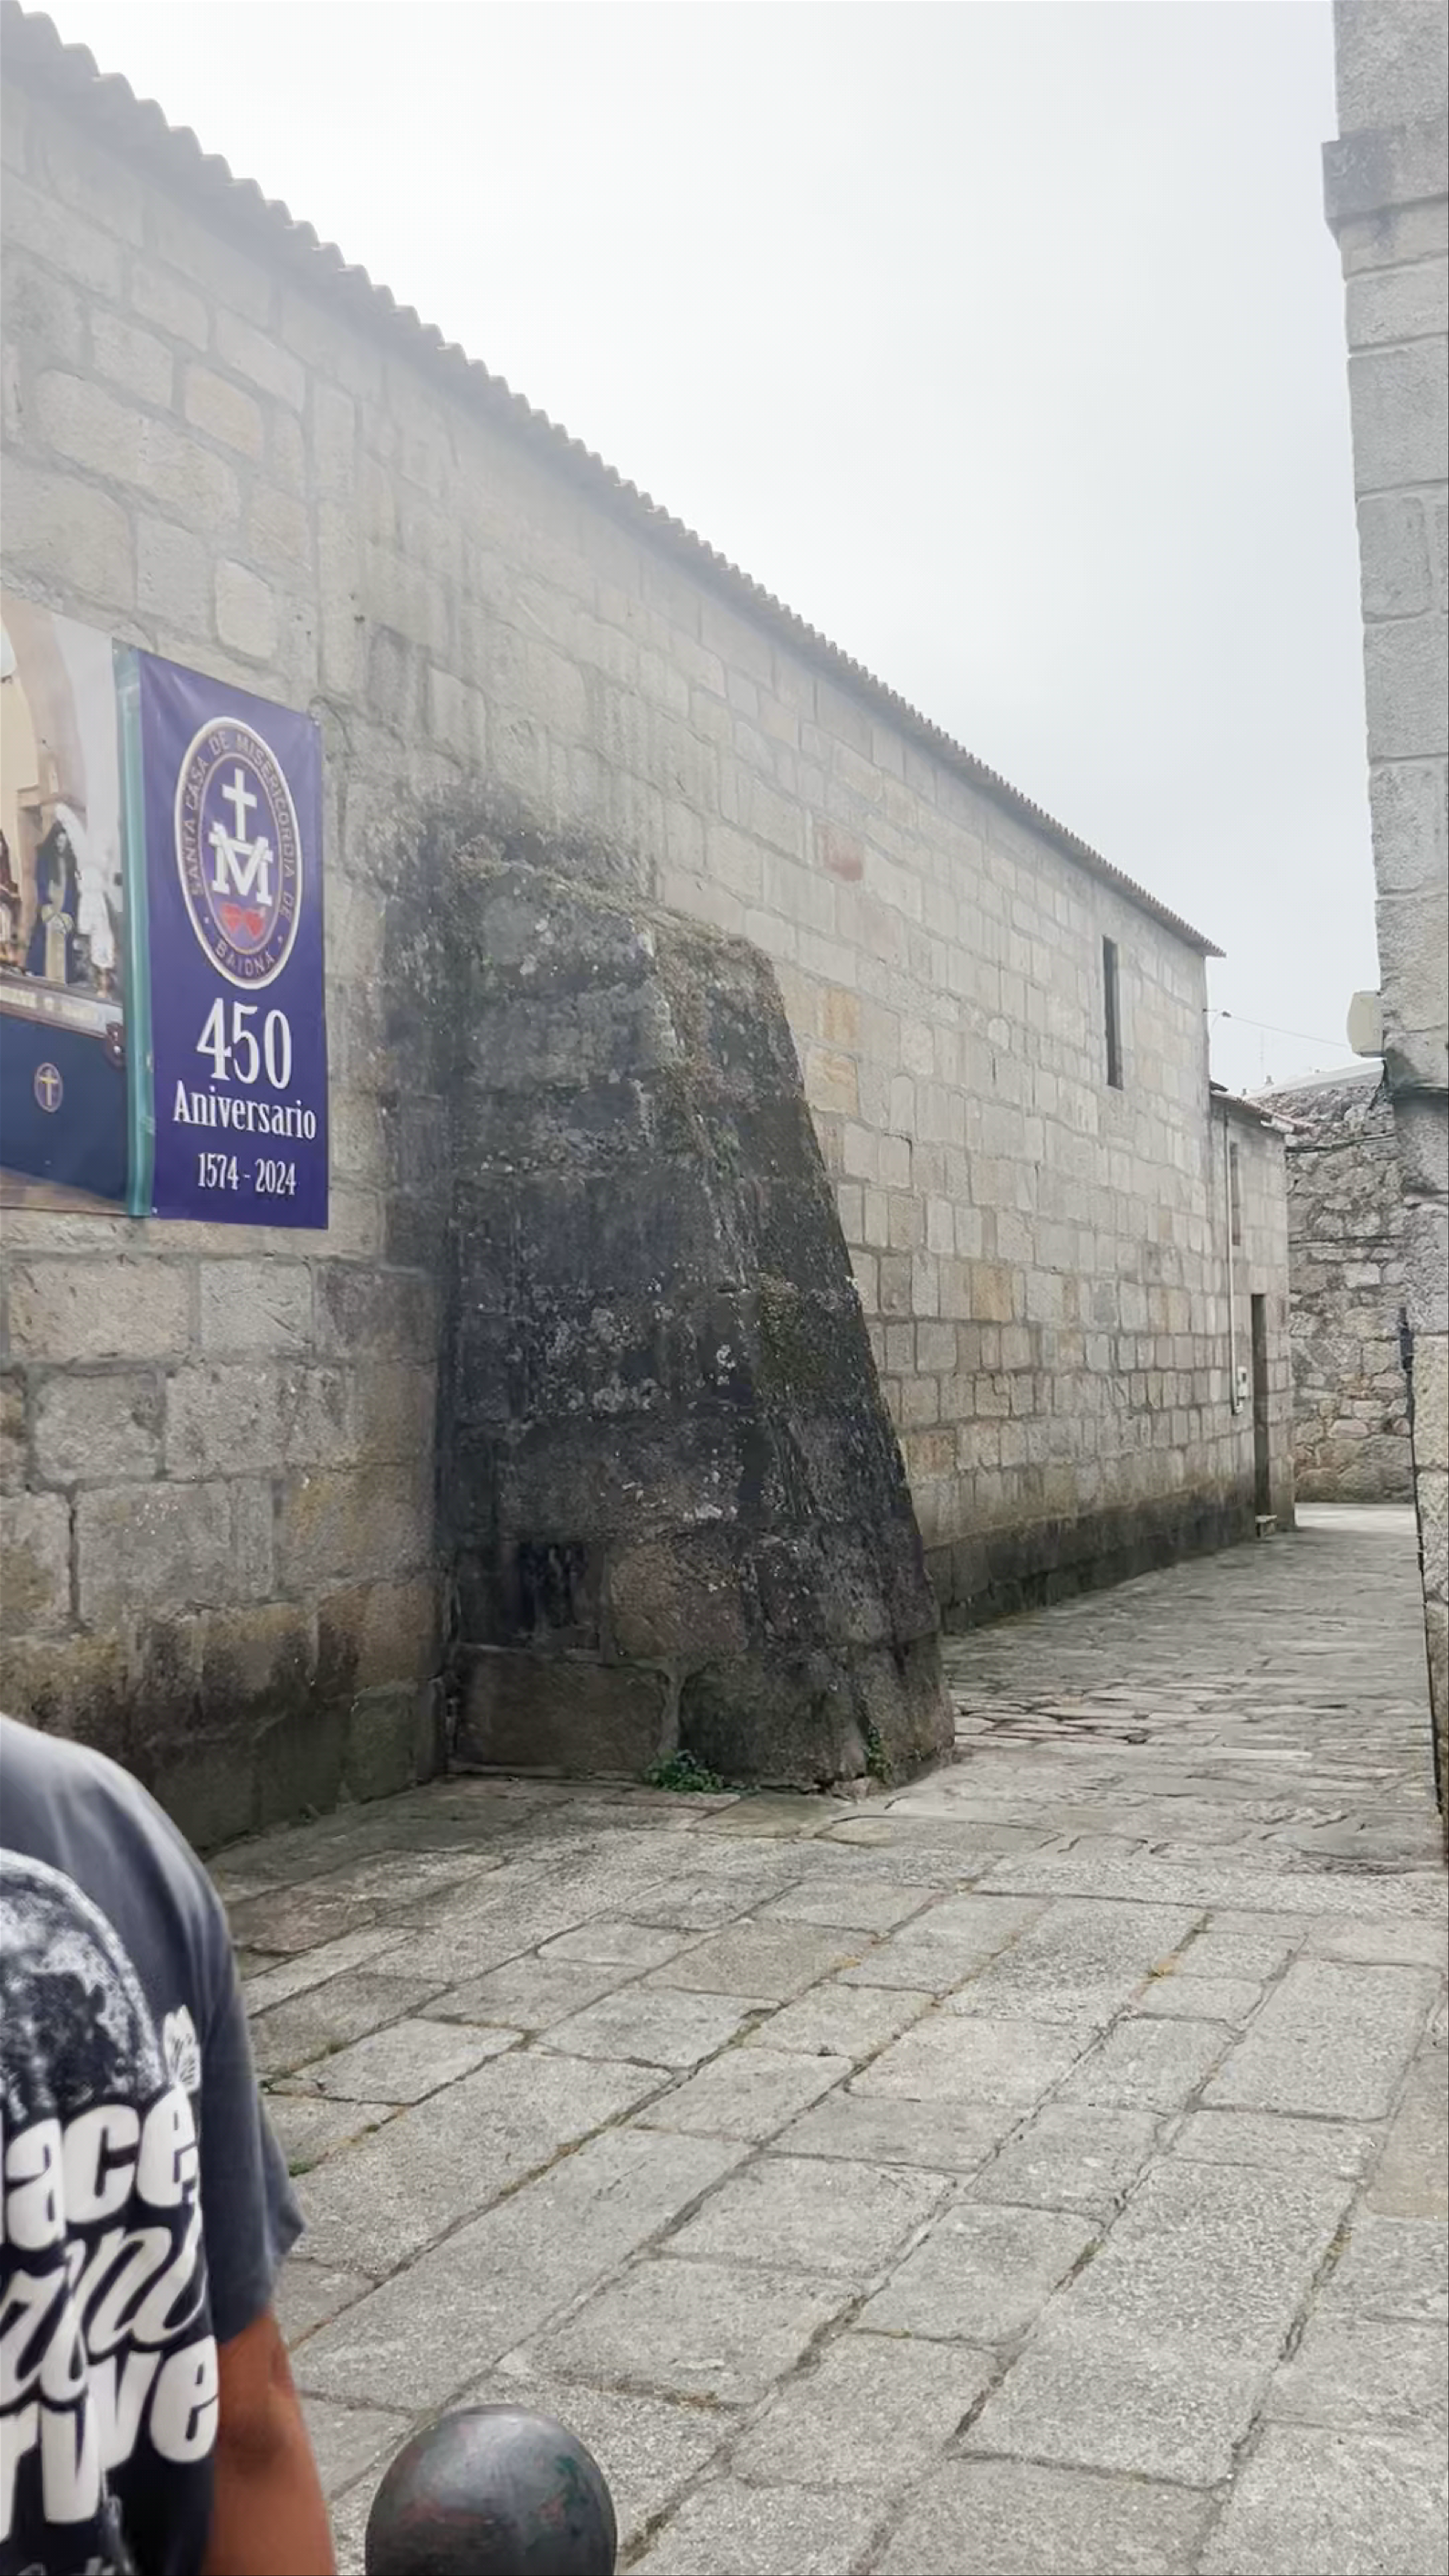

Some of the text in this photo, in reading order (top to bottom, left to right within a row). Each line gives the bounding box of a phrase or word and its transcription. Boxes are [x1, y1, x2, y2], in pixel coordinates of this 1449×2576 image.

[209, 731, 230, 756] DE
[186, 756, 209, 810] CASA
[235, 733, 296, 878] MISERICORDIA
[183, 818, 205, 896] SANTA
[215, 938, 275, 977] BAIONA
[196, 997, 292, 1089] 450
[172, 1080, 317, 1140] Aniversario
[198, 1152, 240, 1191] 1574
[255, 1158, 297, 1196] 2024
[0, 2084, 200, 2250] ace
